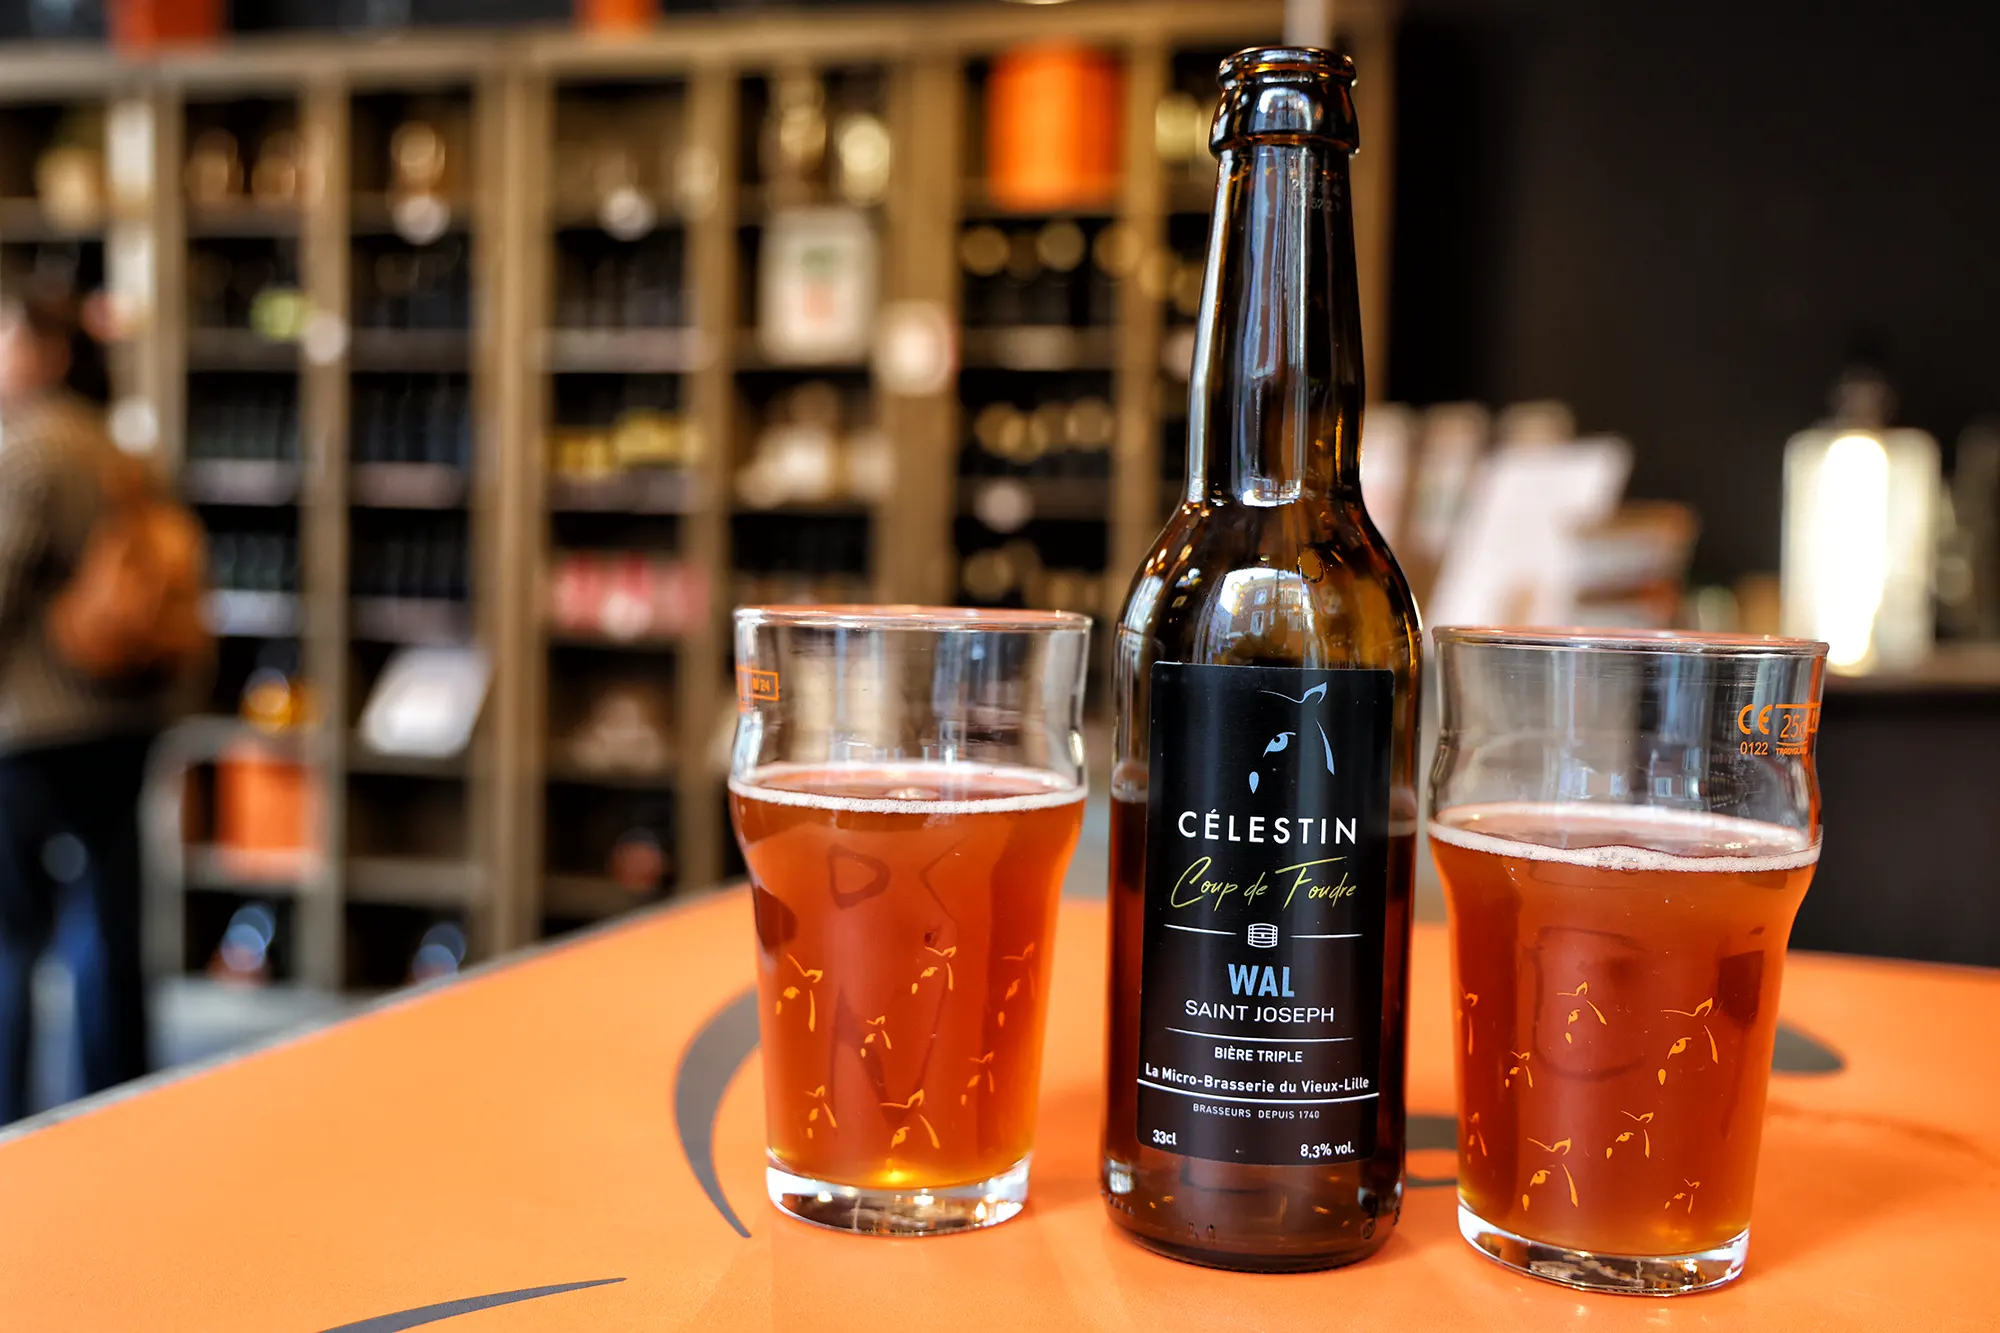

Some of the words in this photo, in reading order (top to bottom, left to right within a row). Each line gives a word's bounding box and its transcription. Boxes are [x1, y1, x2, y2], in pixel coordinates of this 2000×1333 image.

[1740, 741, 1768, 755] 0122
[1178, 809, 1357, 845] CÉLESTIN
[1171, 856, 1239, 912] Coup
[1243, 871, 1268, 906] de
[1275, 856, 1357, 911] Foudre
[1227, 963, 1295, 998] WAL
[1185, 999, 1249, 1022] SAINT
[1254, 1005, 1335, 1023] JOSEPH
[1214, 1045, 1253, 1062] BIÈRE
[1257, 1050, 1303, 1063] TRIPLE
[1145, 1063, 1159, 1078] La
[1162, 1067, 1275, 1093] Micro-Brasserie
[1279, 1081, 1297, 1094] du
[1301, 1077, 1370, 1094] Vieux-Lille
[1192, 1103, 1252, 1119] BRASSEURS
[1258, 1110, 1295, 1120] DEPUIS
[1299, 1110, 1320, 1120] 1740
[1152, 1129, 1177, 1146] 33cl
[1300, 1143, 1332, 1158] 8,3%
[1334, 1141, 1355, 1155] vol.
